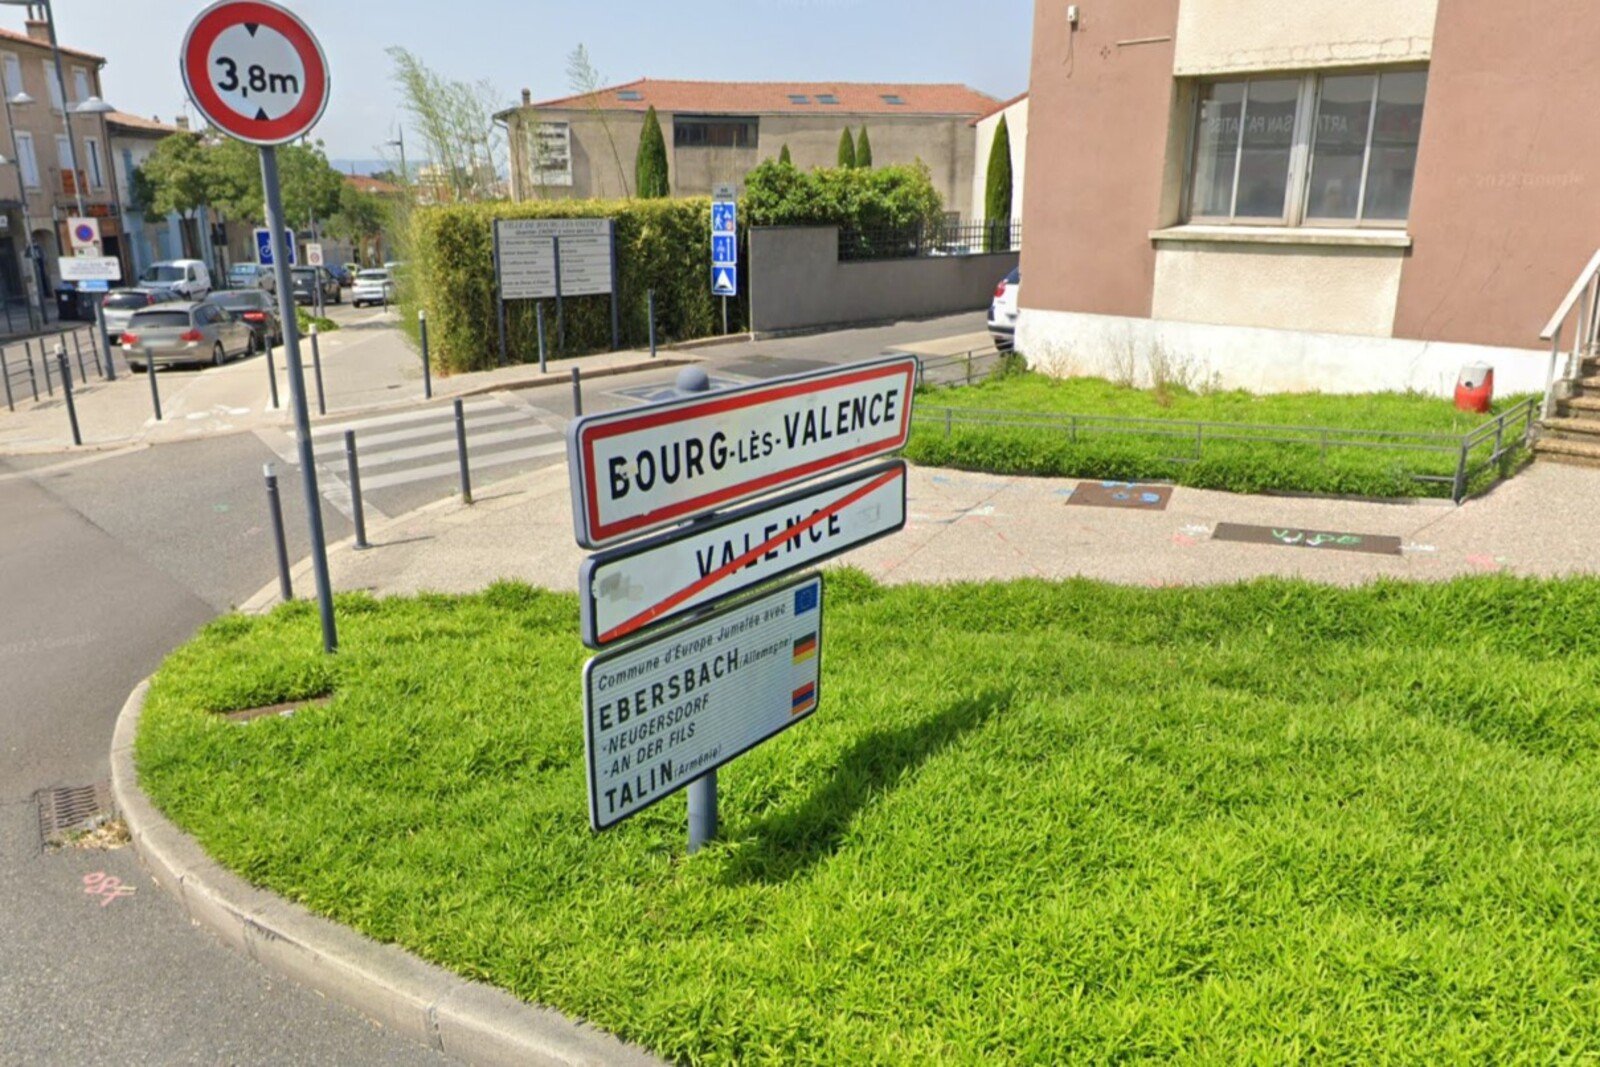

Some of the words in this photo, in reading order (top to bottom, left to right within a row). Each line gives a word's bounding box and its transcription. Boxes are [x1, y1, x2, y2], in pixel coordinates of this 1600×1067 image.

[215, 56, 299, 98] 3,8m
[608, 389, 899, 500] BOURG-LÈS-VALENCE
[696, 509, 841, 579] VALENCE
[599, 656, 660, 691] Commune
[664, 632, 714, 666] d'Europe
[764, 603, 786, 620] avec
[600, 648, 740, 731] EBERSBACH
[637, 739, 663, 765] DER
[669, 722, 696, 750] FILS
[605, 759, 674, 814] TALIN
